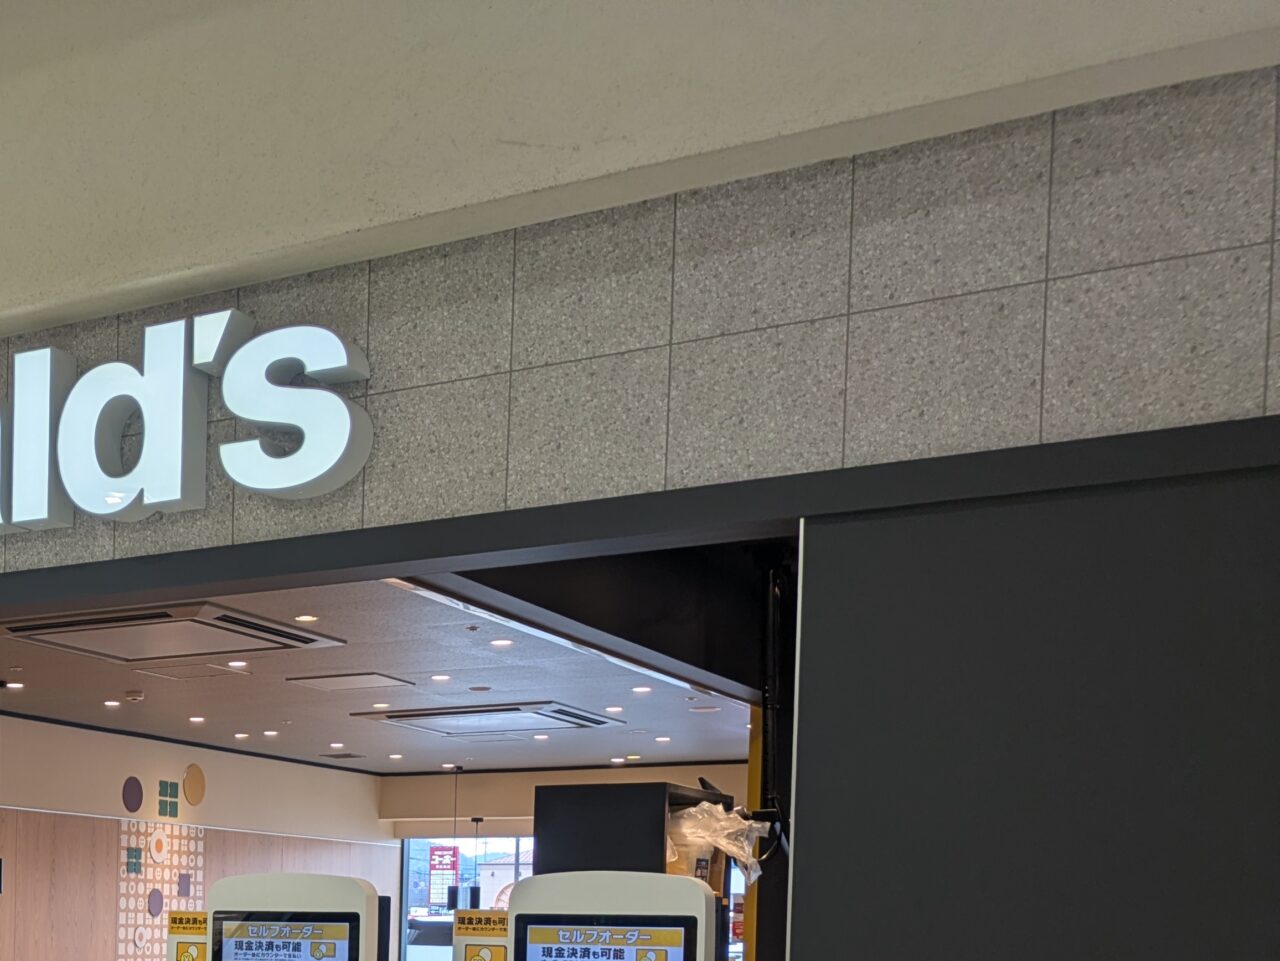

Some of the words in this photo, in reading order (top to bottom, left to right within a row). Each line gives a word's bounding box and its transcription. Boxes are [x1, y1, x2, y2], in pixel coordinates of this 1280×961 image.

[457, 915, 508, 926] 現金決済も可
[247, 925, 323, 938] セルフオーダー
[558, 929, 651, 944] セルフオーダー
[234, 940, 302, 952] 現金決済も可能
[541, 946, 625, 960] 現金決済も可能
